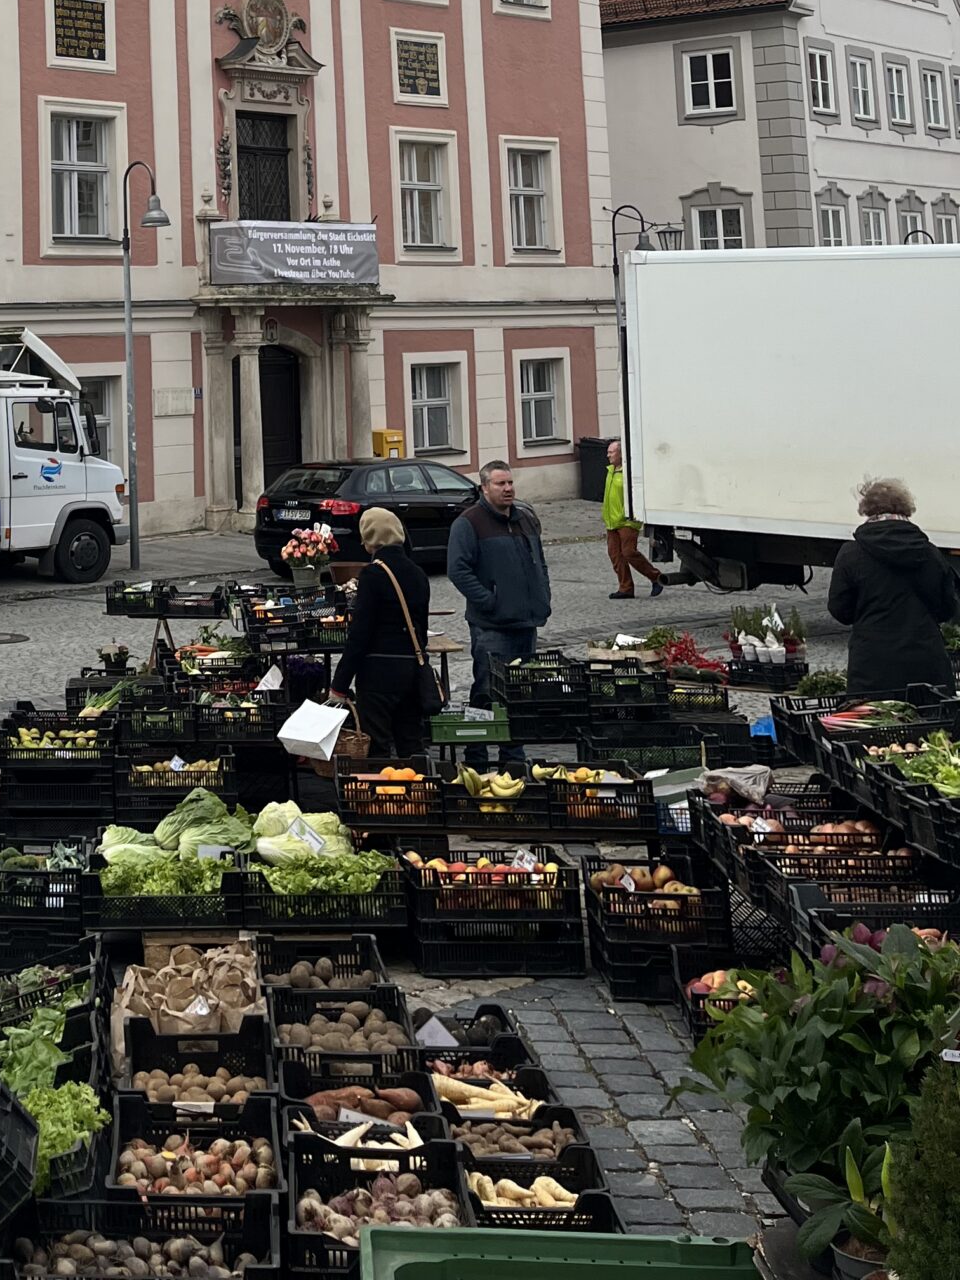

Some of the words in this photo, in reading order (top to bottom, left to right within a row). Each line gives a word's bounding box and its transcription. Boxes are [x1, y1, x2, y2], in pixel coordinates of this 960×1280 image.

[248, 230, 315, 242] Bürgerversammlung
[317, 231, 328, 240] der
[329, 231, 346, 241] Stadt
[347, 231, 376, 241] Eichstätt
[272, 243, 283, 253] 17.
[285, 243, 327, 255] November,
[329, 244, 338, 254] 18
[339, 244, 353, 254] Uhr
[287, 257, 298, 266] Vor
[300, 257, 311, 266] Ort
[312, 256, 321, 266] im
[311, 268, 327, 278] über
[327, 269, 355, 279] YouTube
